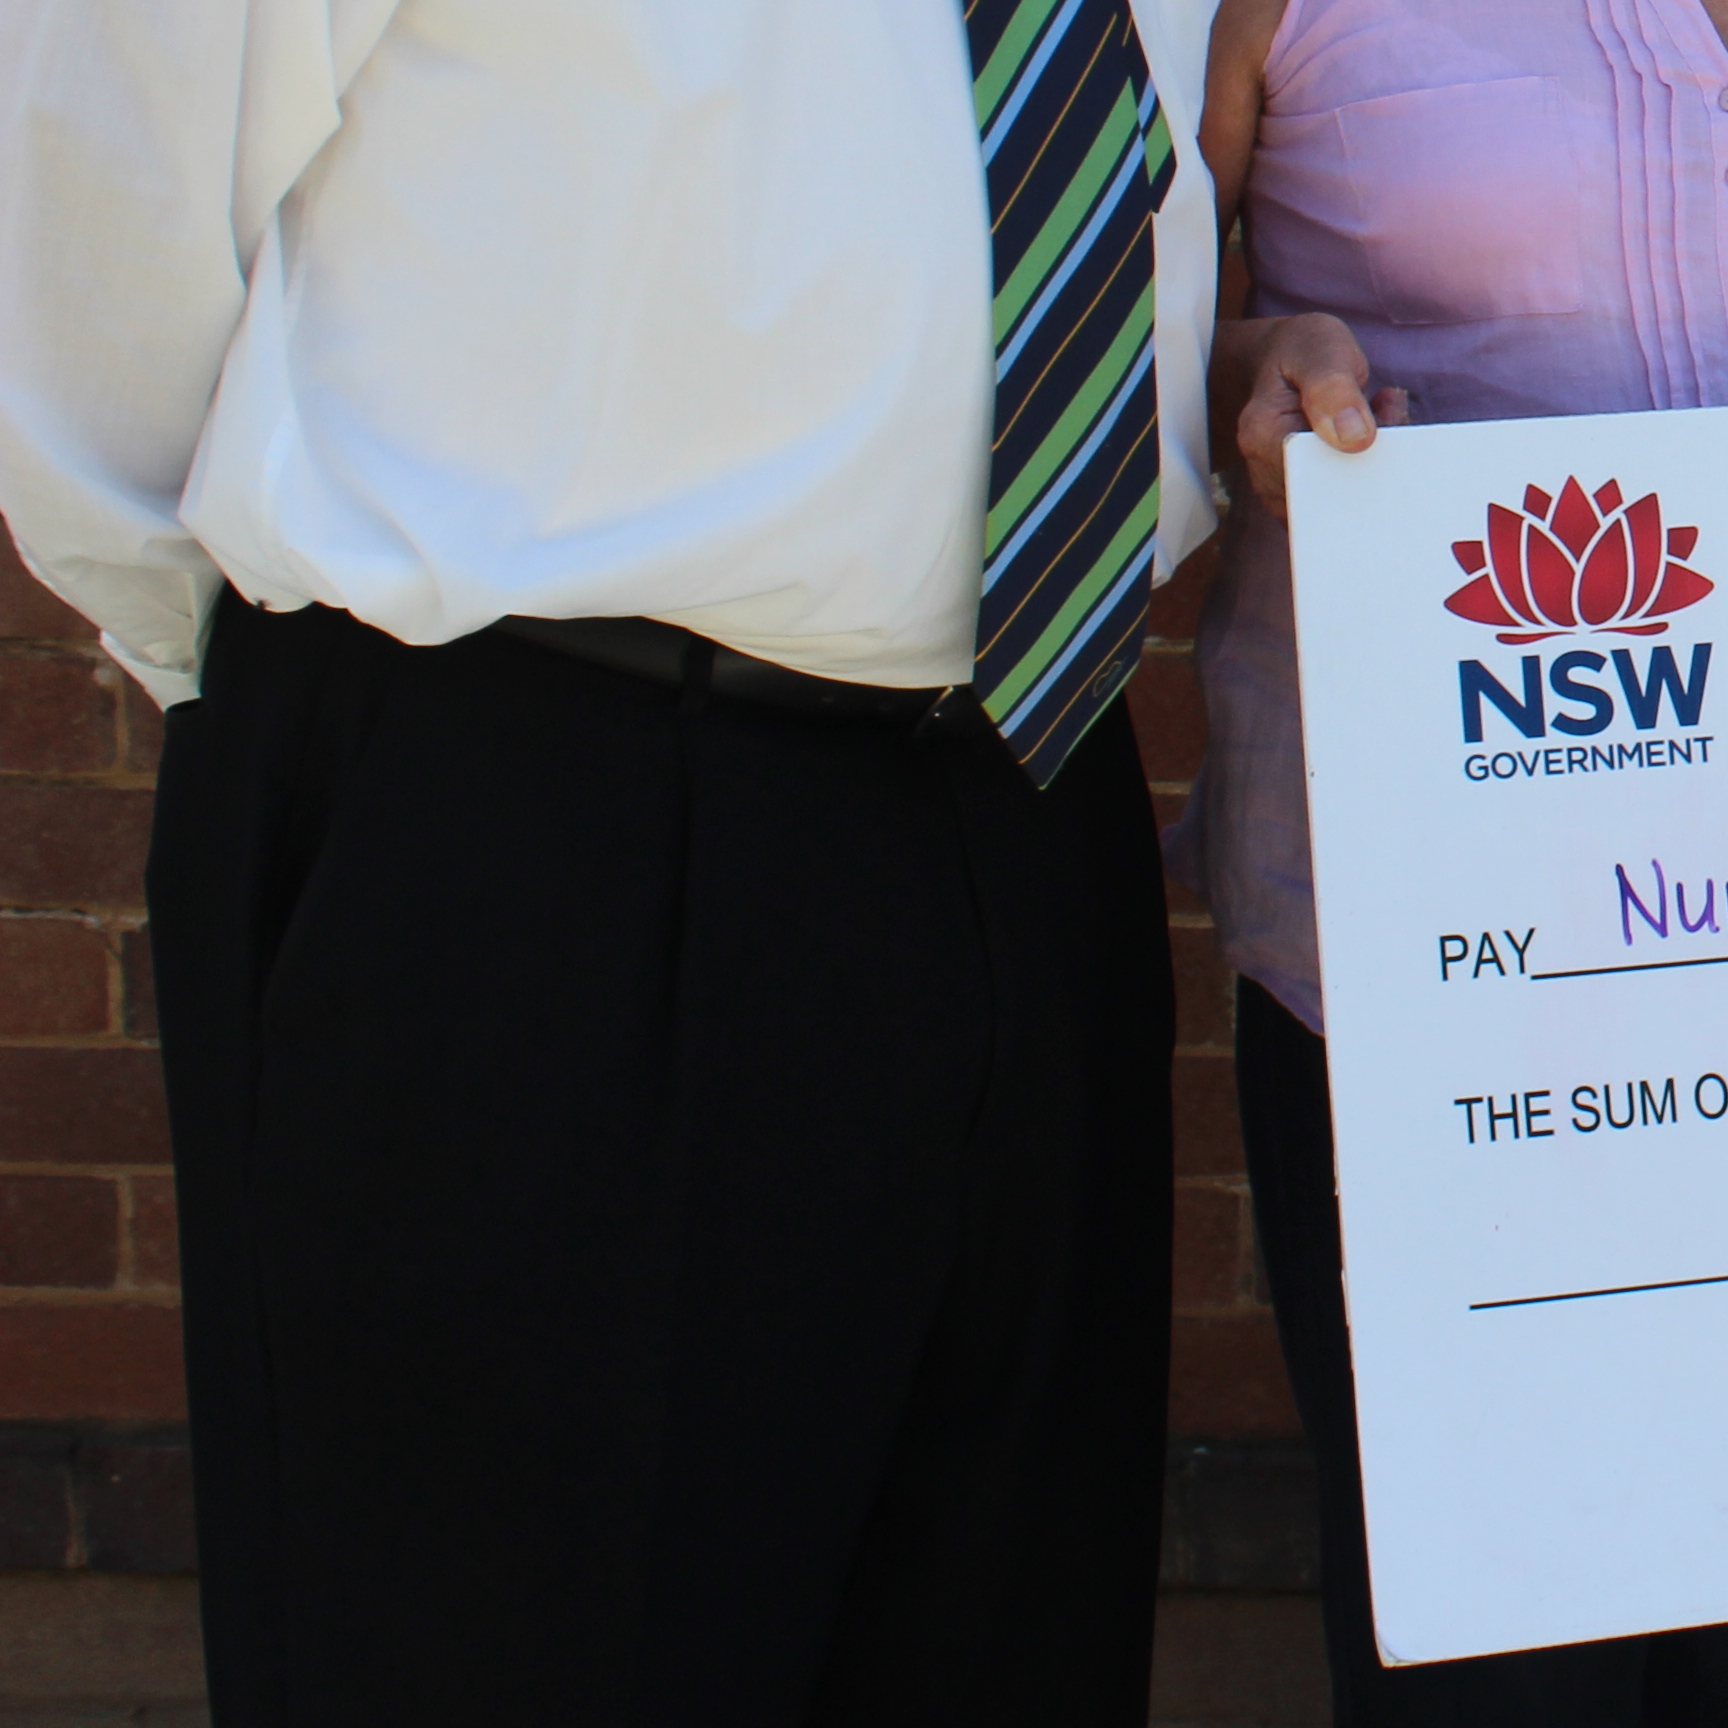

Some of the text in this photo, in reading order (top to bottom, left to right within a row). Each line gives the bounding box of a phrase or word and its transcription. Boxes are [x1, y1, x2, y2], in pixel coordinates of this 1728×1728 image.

[1457, 641, 1713, 745] NSW
[1462, 736, 1714, 783] GOVERNMENT
[1438, 927, 1536, 983] PAY
[1452, 1089, 1556, 1146] THE
[1569, 1077, 1678, 1135] SUM
